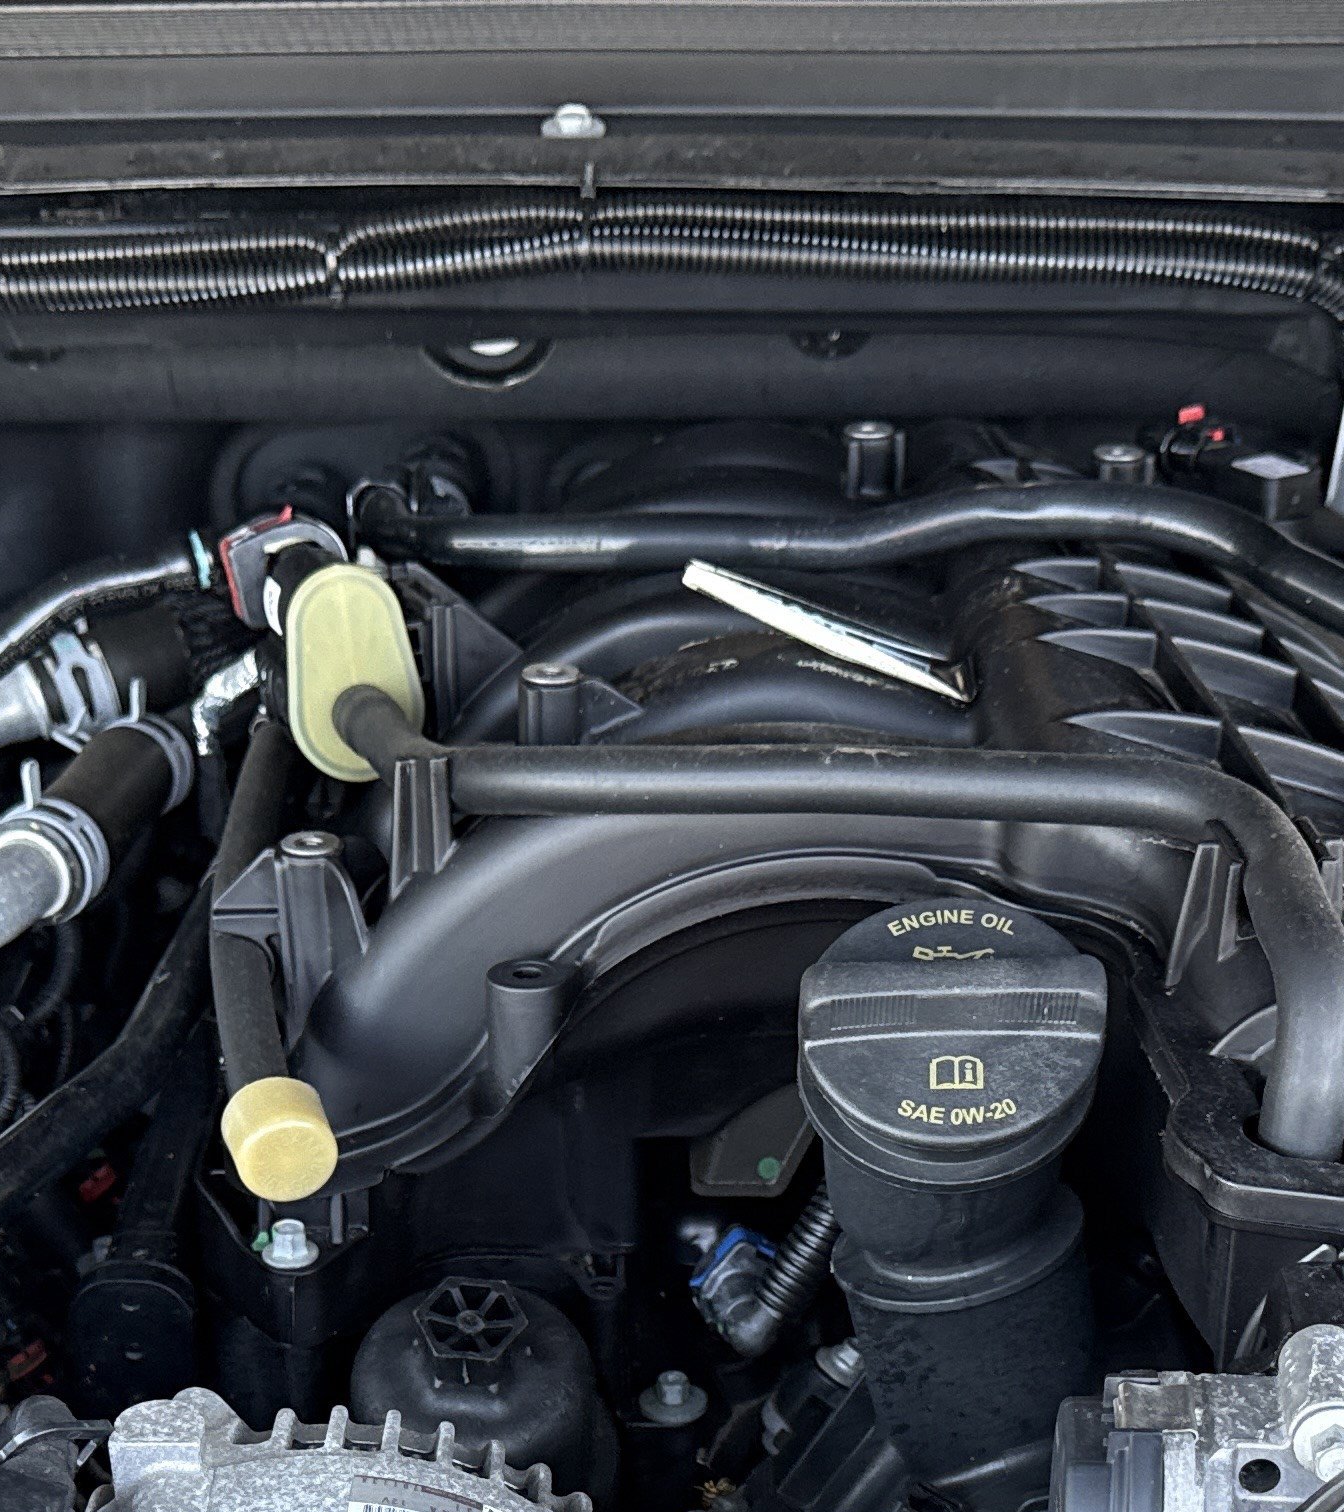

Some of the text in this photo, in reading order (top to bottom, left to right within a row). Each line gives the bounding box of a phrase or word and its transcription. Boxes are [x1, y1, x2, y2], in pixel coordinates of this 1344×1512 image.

[887, 909, 1015, 937] ENGINE OIL
[897, 1098, 1017, 1125] SAE 0W-20
